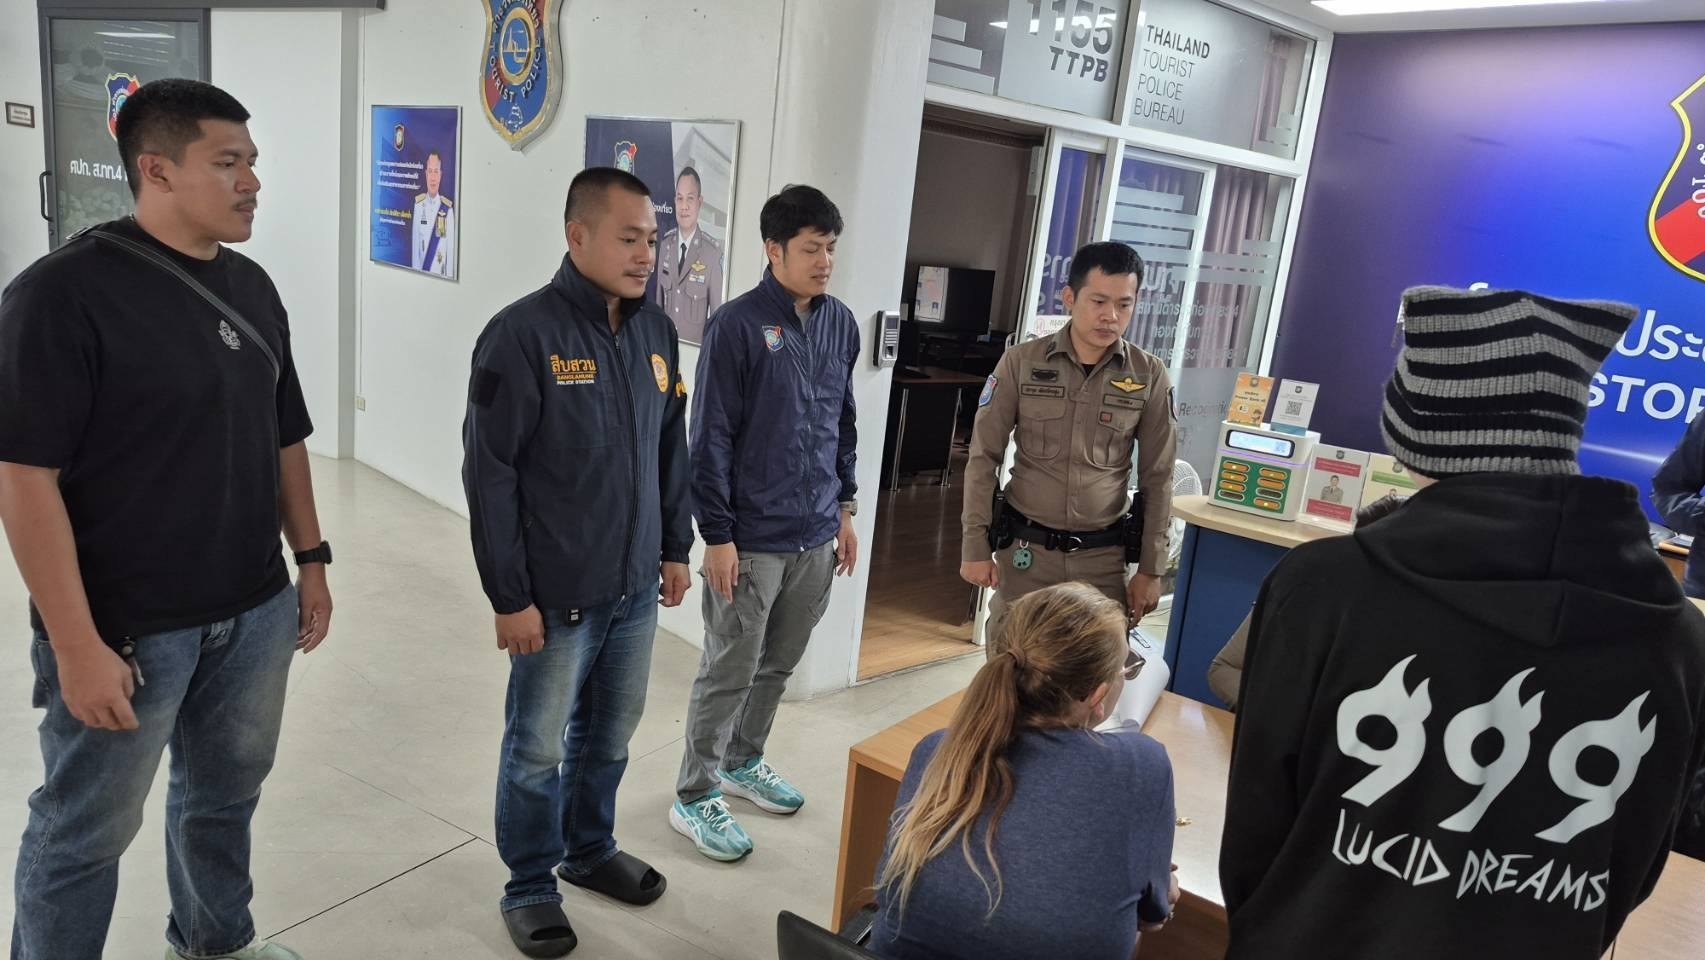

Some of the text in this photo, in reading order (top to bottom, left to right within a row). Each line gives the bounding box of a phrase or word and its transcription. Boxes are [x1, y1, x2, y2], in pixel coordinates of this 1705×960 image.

[1027, 0, 1116, 54] 1155
[1147, 25, 1211, 59] THAILAND
[490, 37, 541, 102] TOURIST POLICE
[1049, 46, 1109, 82] TTPB
[1143, 49, 1196, 78] TOURIST
[1138, 73, 1184, 101] POLICE
[1134, 98, 1185, 125] BUREAU
[1336, 654, 1657, 843] 999
[1332, 808, 1609, 911] LUCID DREAMS
